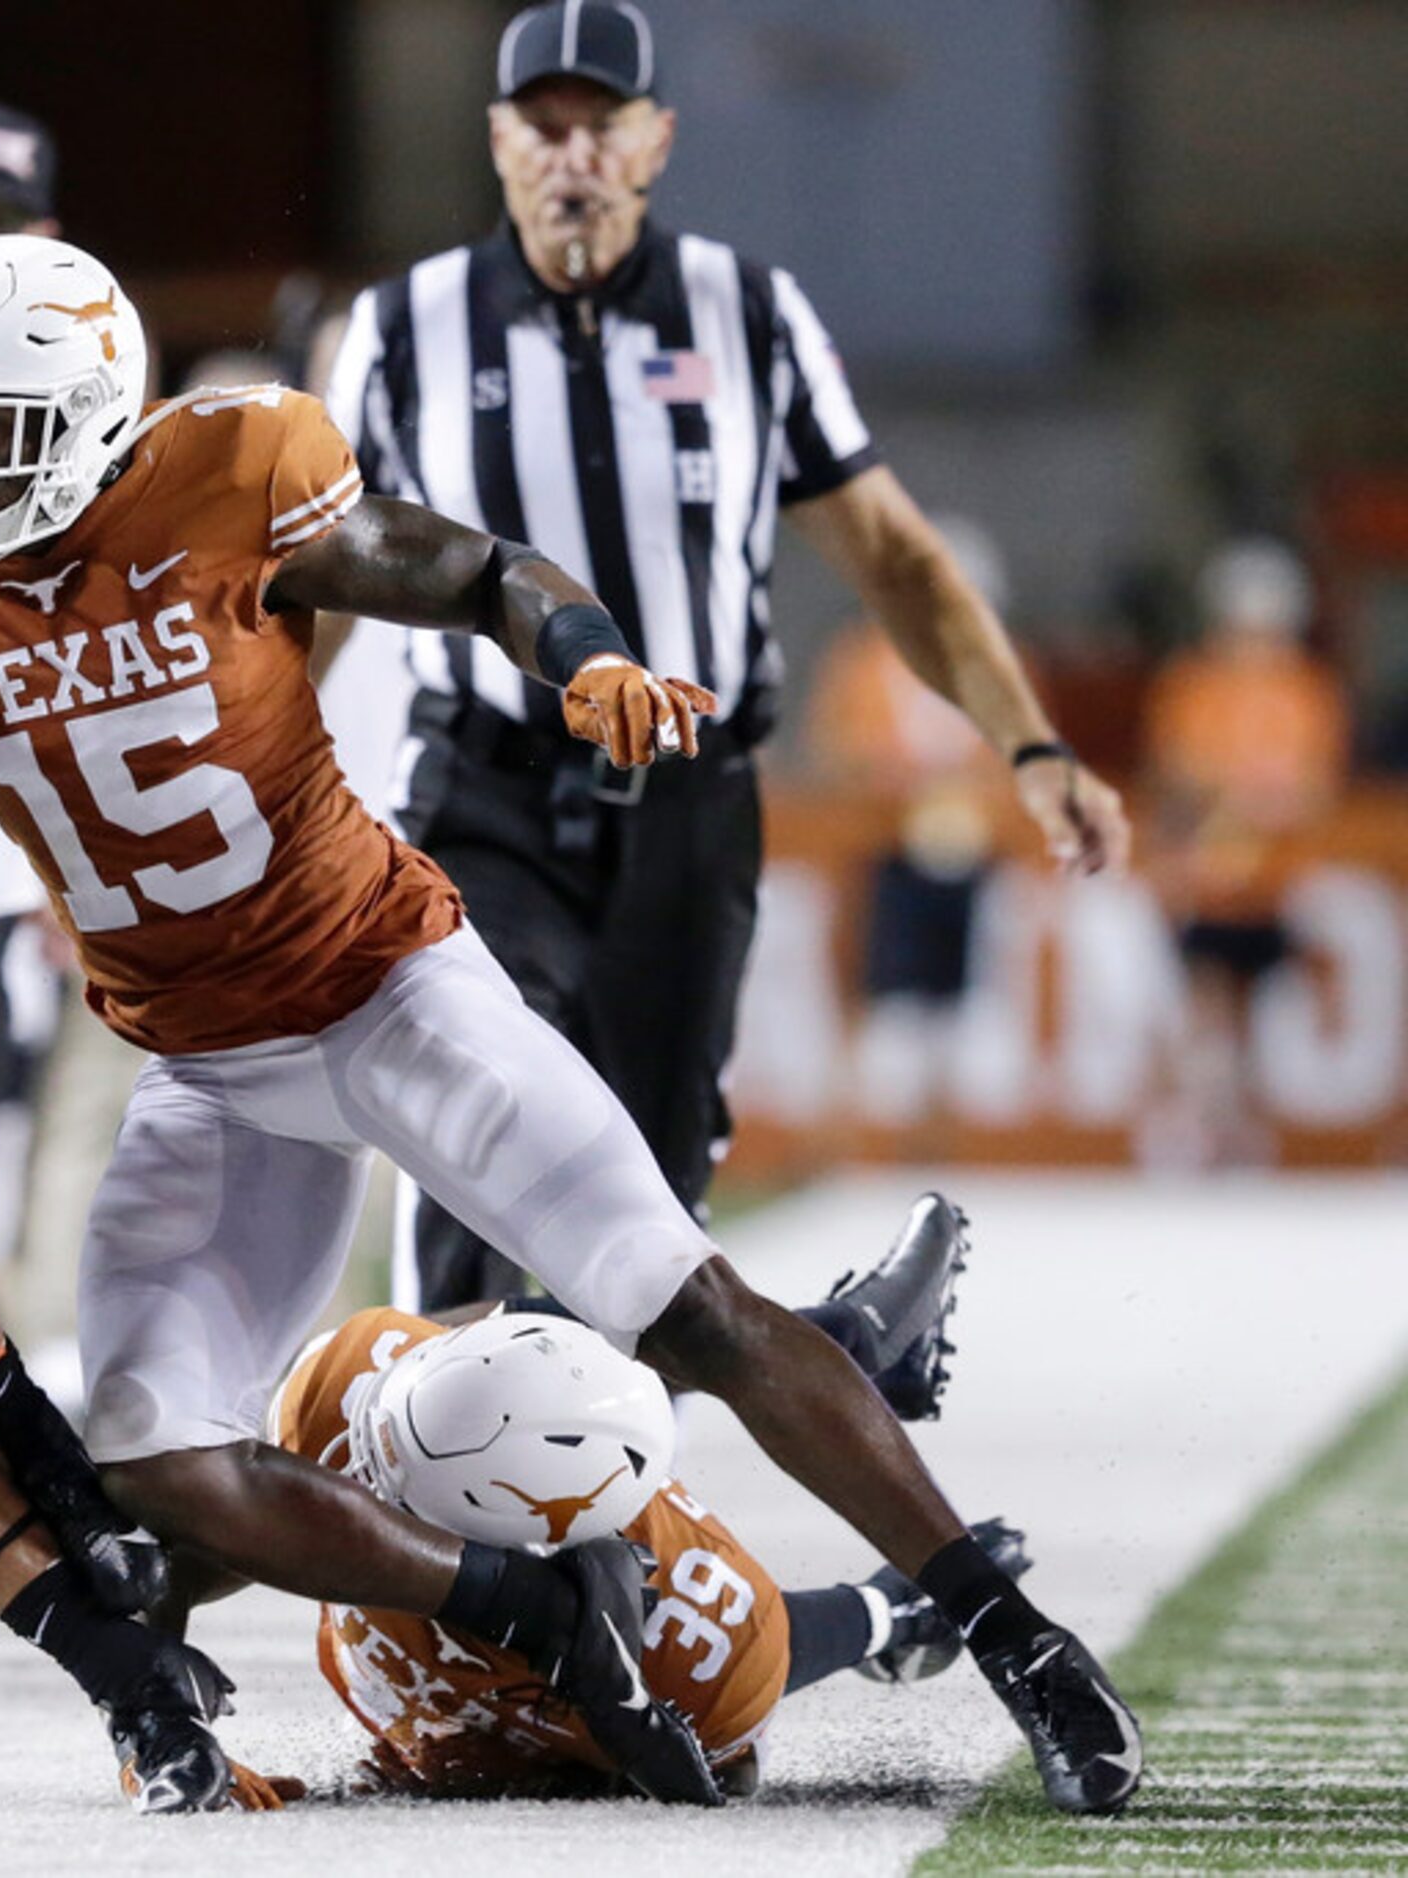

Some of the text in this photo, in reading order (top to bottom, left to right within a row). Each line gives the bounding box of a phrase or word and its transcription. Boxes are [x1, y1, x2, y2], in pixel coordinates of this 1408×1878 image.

[473, 367, 507, 410] S
[676, 450, 715, 503] H
[643, 1547, 755, 1682] 39
